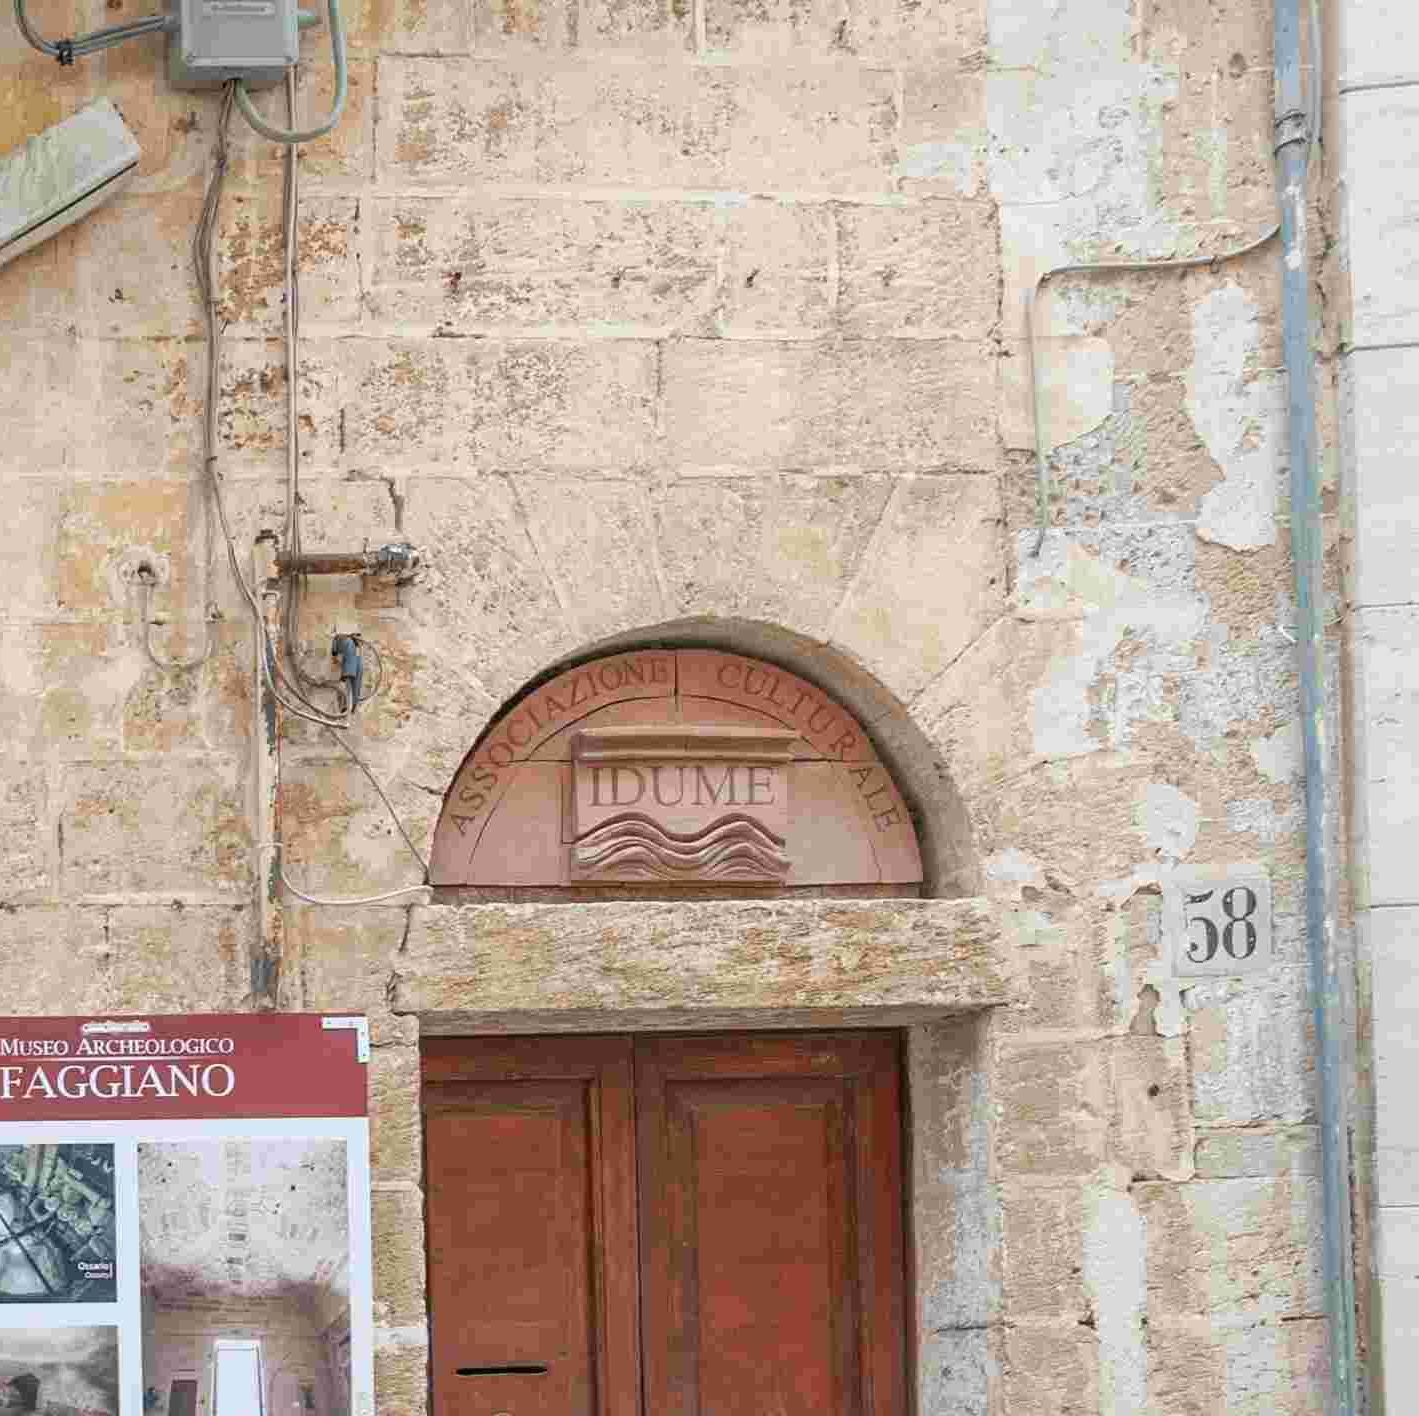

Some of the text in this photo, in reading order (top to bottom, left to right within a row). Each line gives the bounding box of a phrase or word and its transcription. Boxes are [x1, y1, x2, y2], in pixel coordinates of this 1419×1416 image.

[448, 657, 905, 837] ASSOCIAZIONE CULTURALE
[587, 766, 779, 807] IDUME
[1183, 886, 1257, 963] 58
[0, 1038, 234, 1056] MUSEO ARCHEOLOGICO
